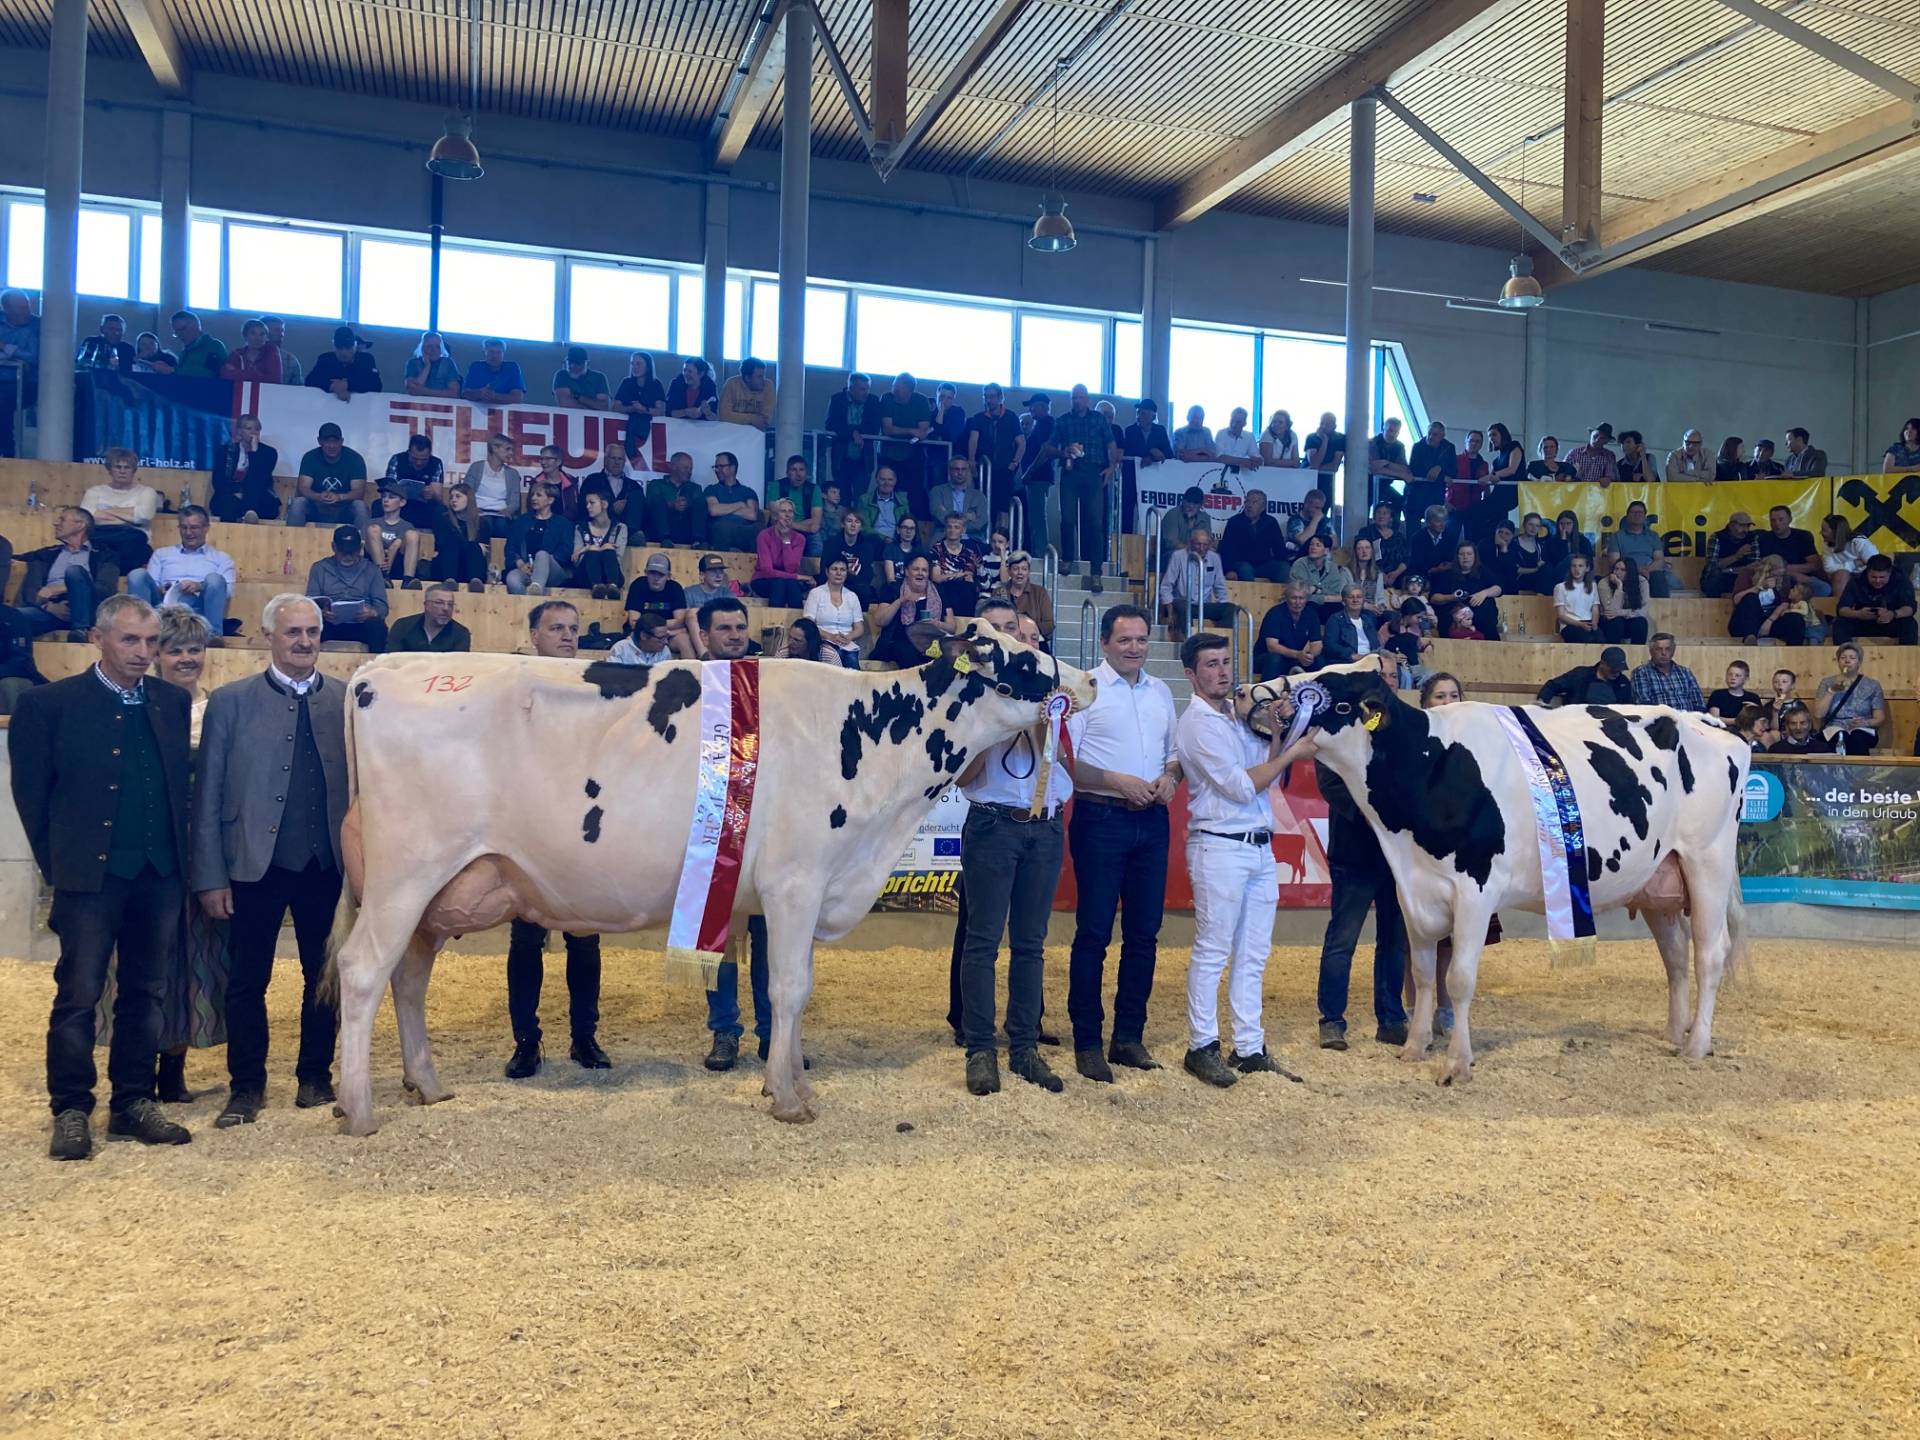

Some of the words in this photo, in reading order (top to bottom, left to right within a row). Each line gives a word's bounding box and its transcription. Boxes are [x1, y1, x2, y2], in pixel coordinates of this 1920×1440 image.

[390, 400, 674, 474] THEURL
[83, 457, 196, 469] wwwrl-holz.at
[1141, 490, 1184, 509] ERDBA
[1203, 493, 1242, 511] SEPP
[1268, 500, 1304, 517] BMER
[422, 674, 473, 694] 132
[1825, 788, 1855, 803] der
[1860, 788, 1912, 804] beste
[1828, 806, 1838, 817] in
[1843, 806, 1868, 818] den
[1872, 807, 1917, 820] Urlaub
[919, 823, 960, 834] nderzucht
[881, 871, 959, 896] pricht!
